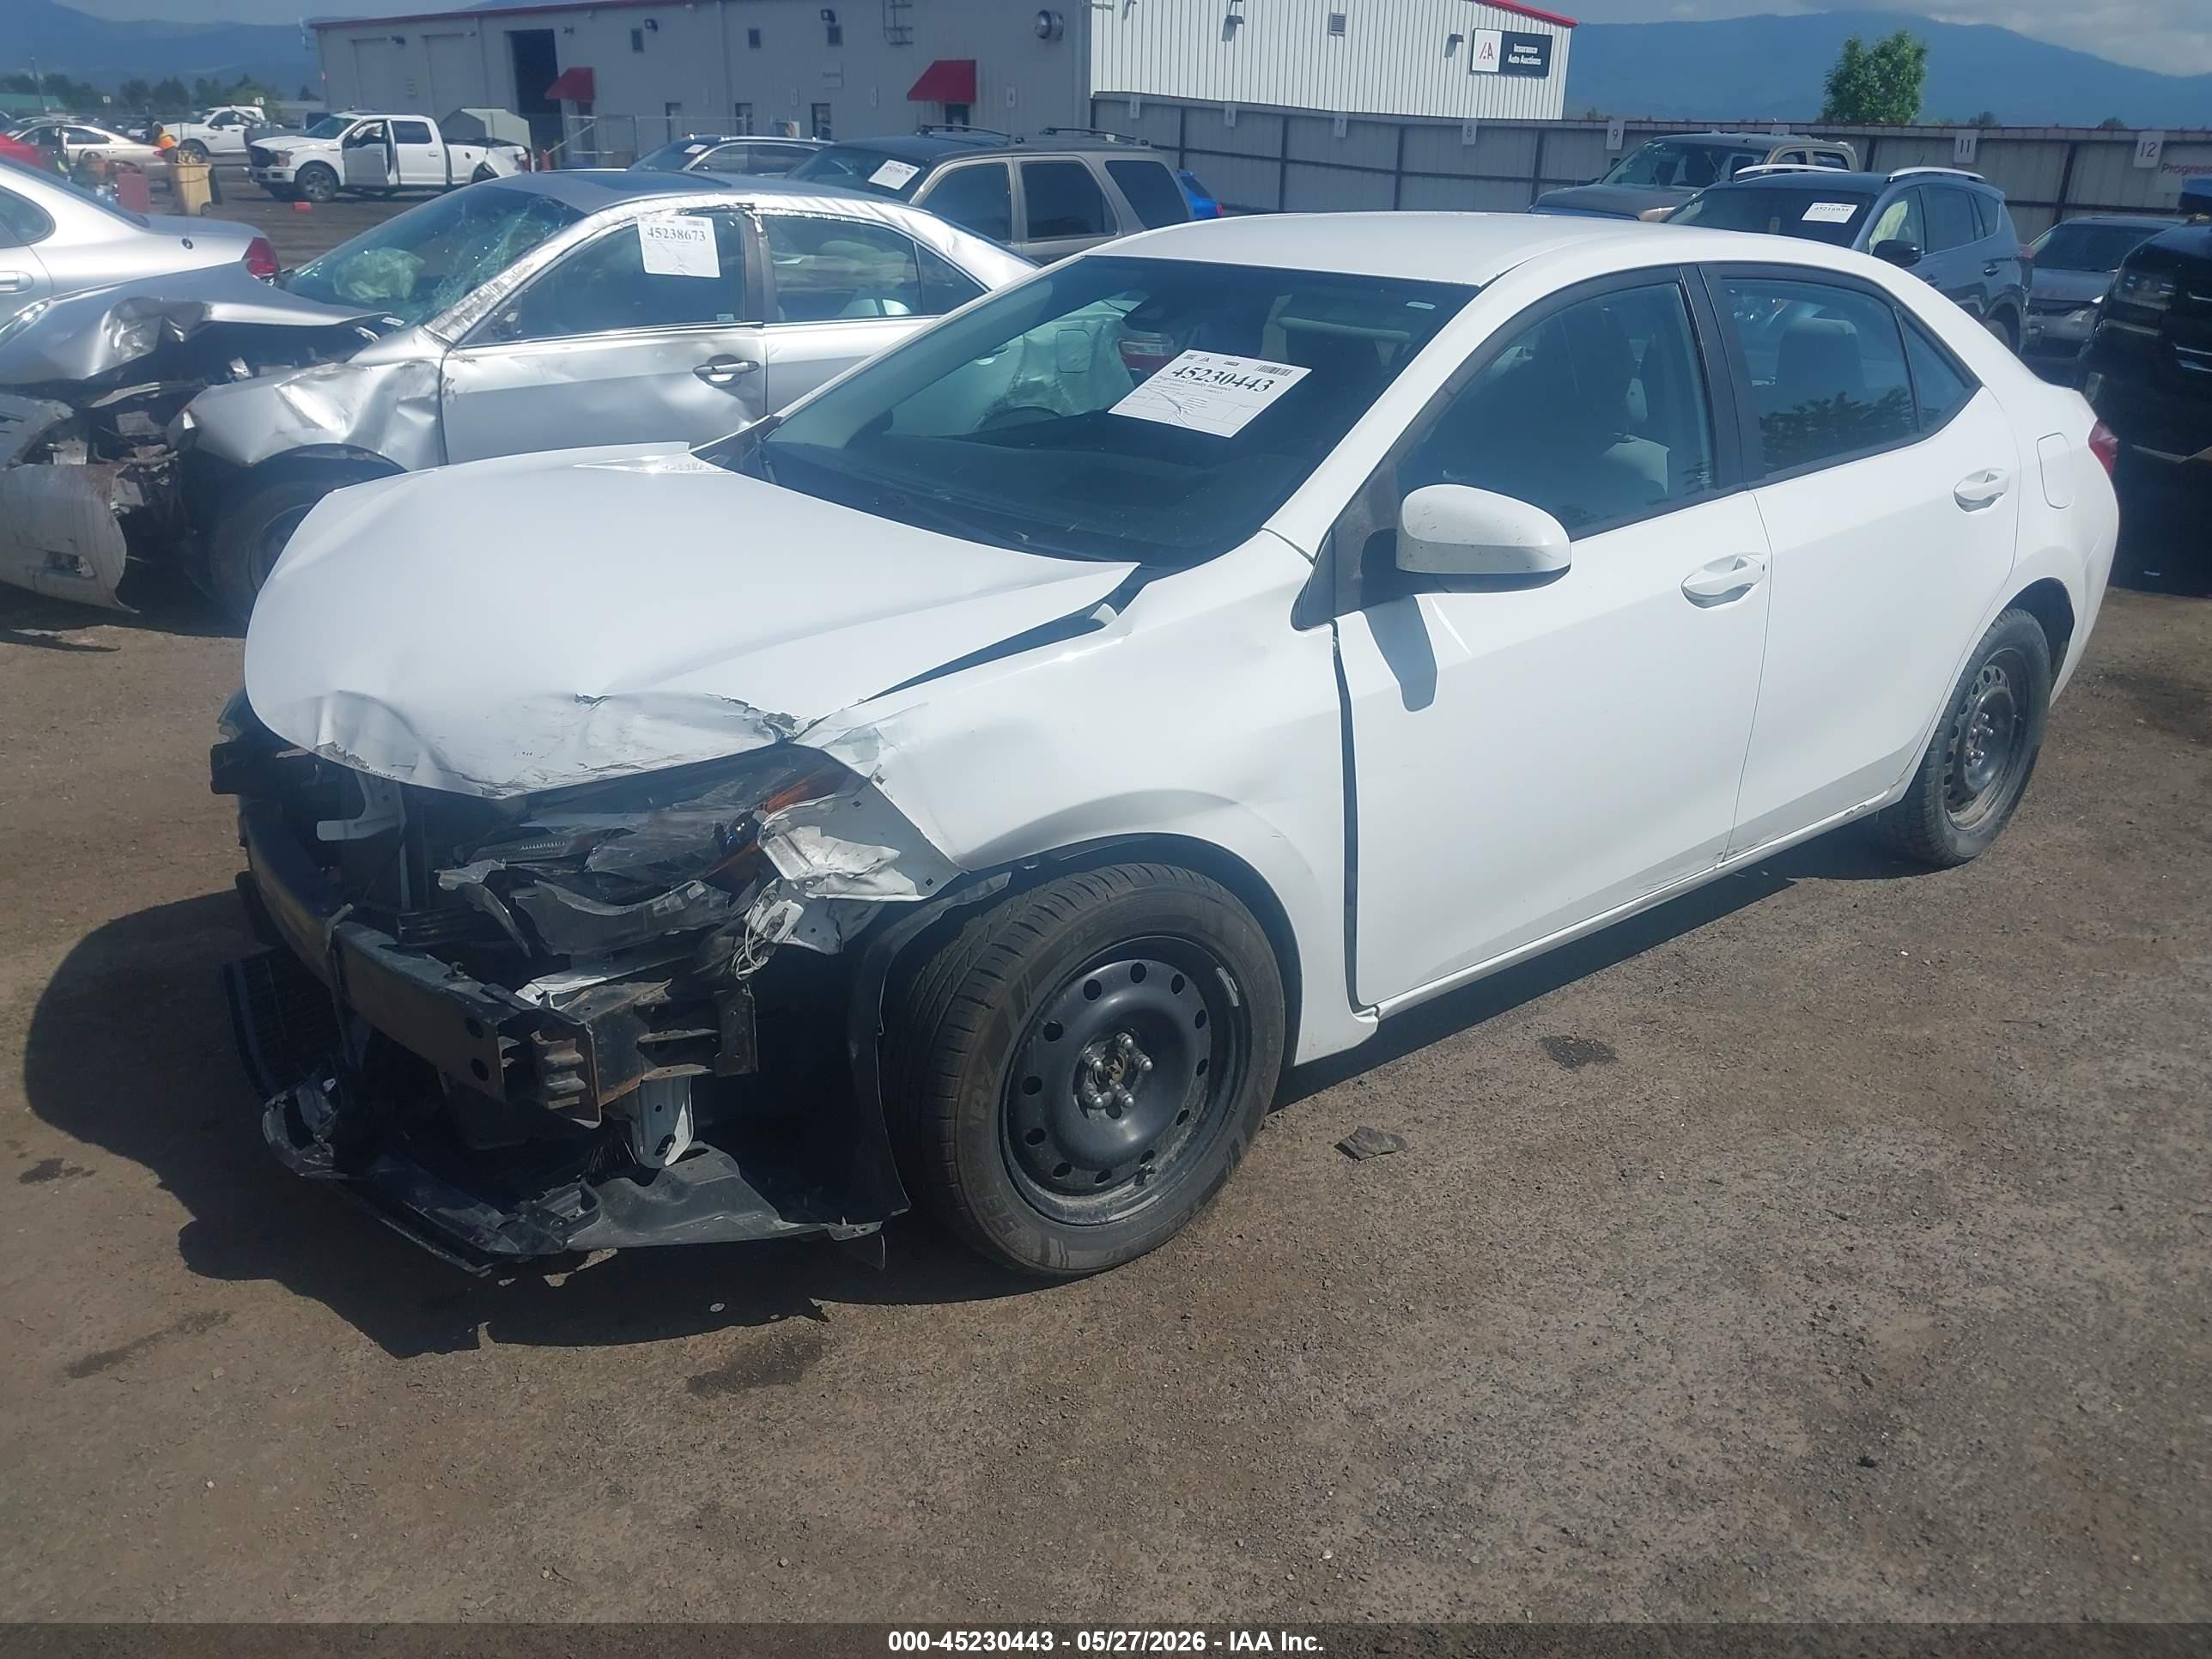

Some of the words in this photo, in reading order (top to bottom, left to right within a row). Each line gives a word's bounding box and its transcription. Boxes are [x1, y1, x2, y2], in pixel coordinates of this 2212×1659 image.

[1514, 44, 1538, 54] Insurance
[1508, 54, 1519, 64] Auto
[1520, 56, 1541, 65] Auctions
[1466, 125, 1472, 137] 8
[1612, 129, 1619, 142] 9
[1959, 137, 1971, 155] 11
[2139, 141, 2157, 159] 12
[647, 227, 706, 241] 45238673
[1172, 367, 1275, 392] 45230443
